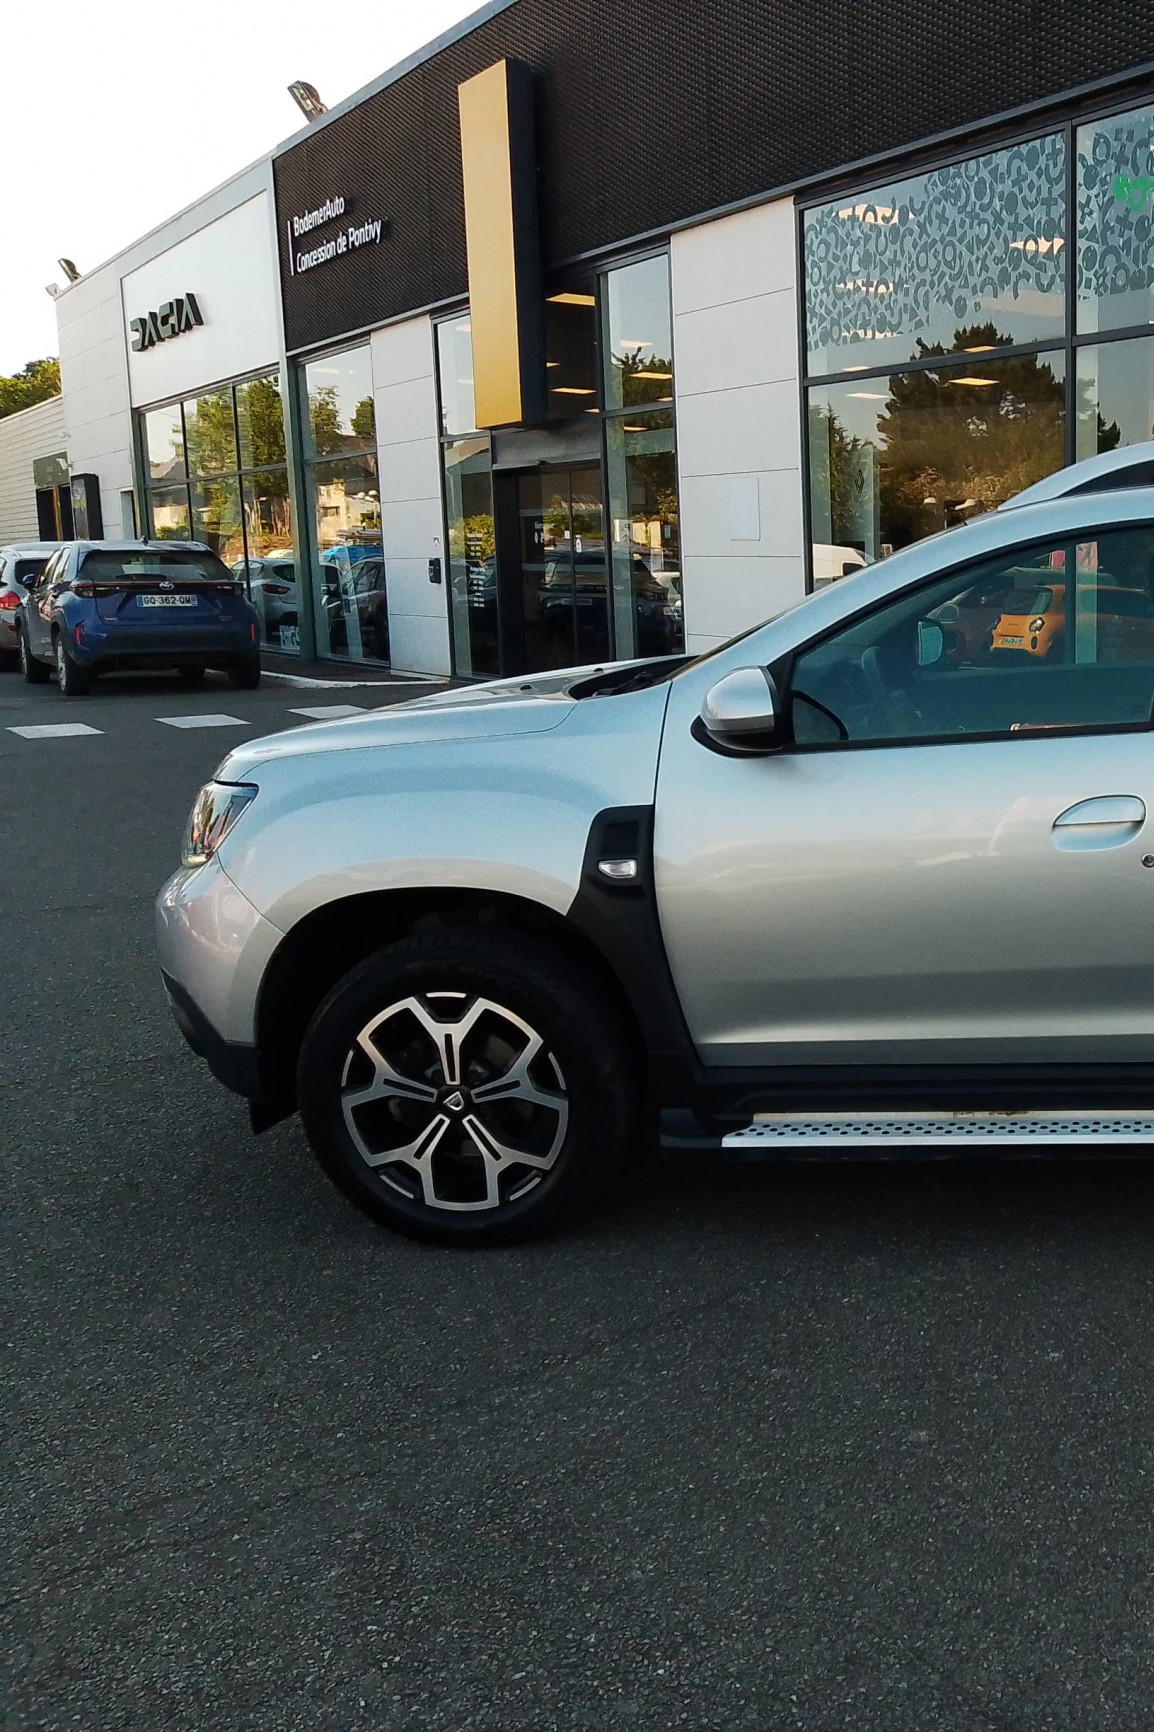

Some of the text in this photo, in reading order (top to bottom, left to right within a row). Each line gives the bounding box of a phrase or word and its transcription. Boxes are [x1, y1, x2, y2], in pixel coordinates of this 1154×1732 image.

[293, 195, 345, 237] BodemerAuto
[296, 217, 382, 273] Concession de Pontivy
[130, 292, 204, 352] DACIA
